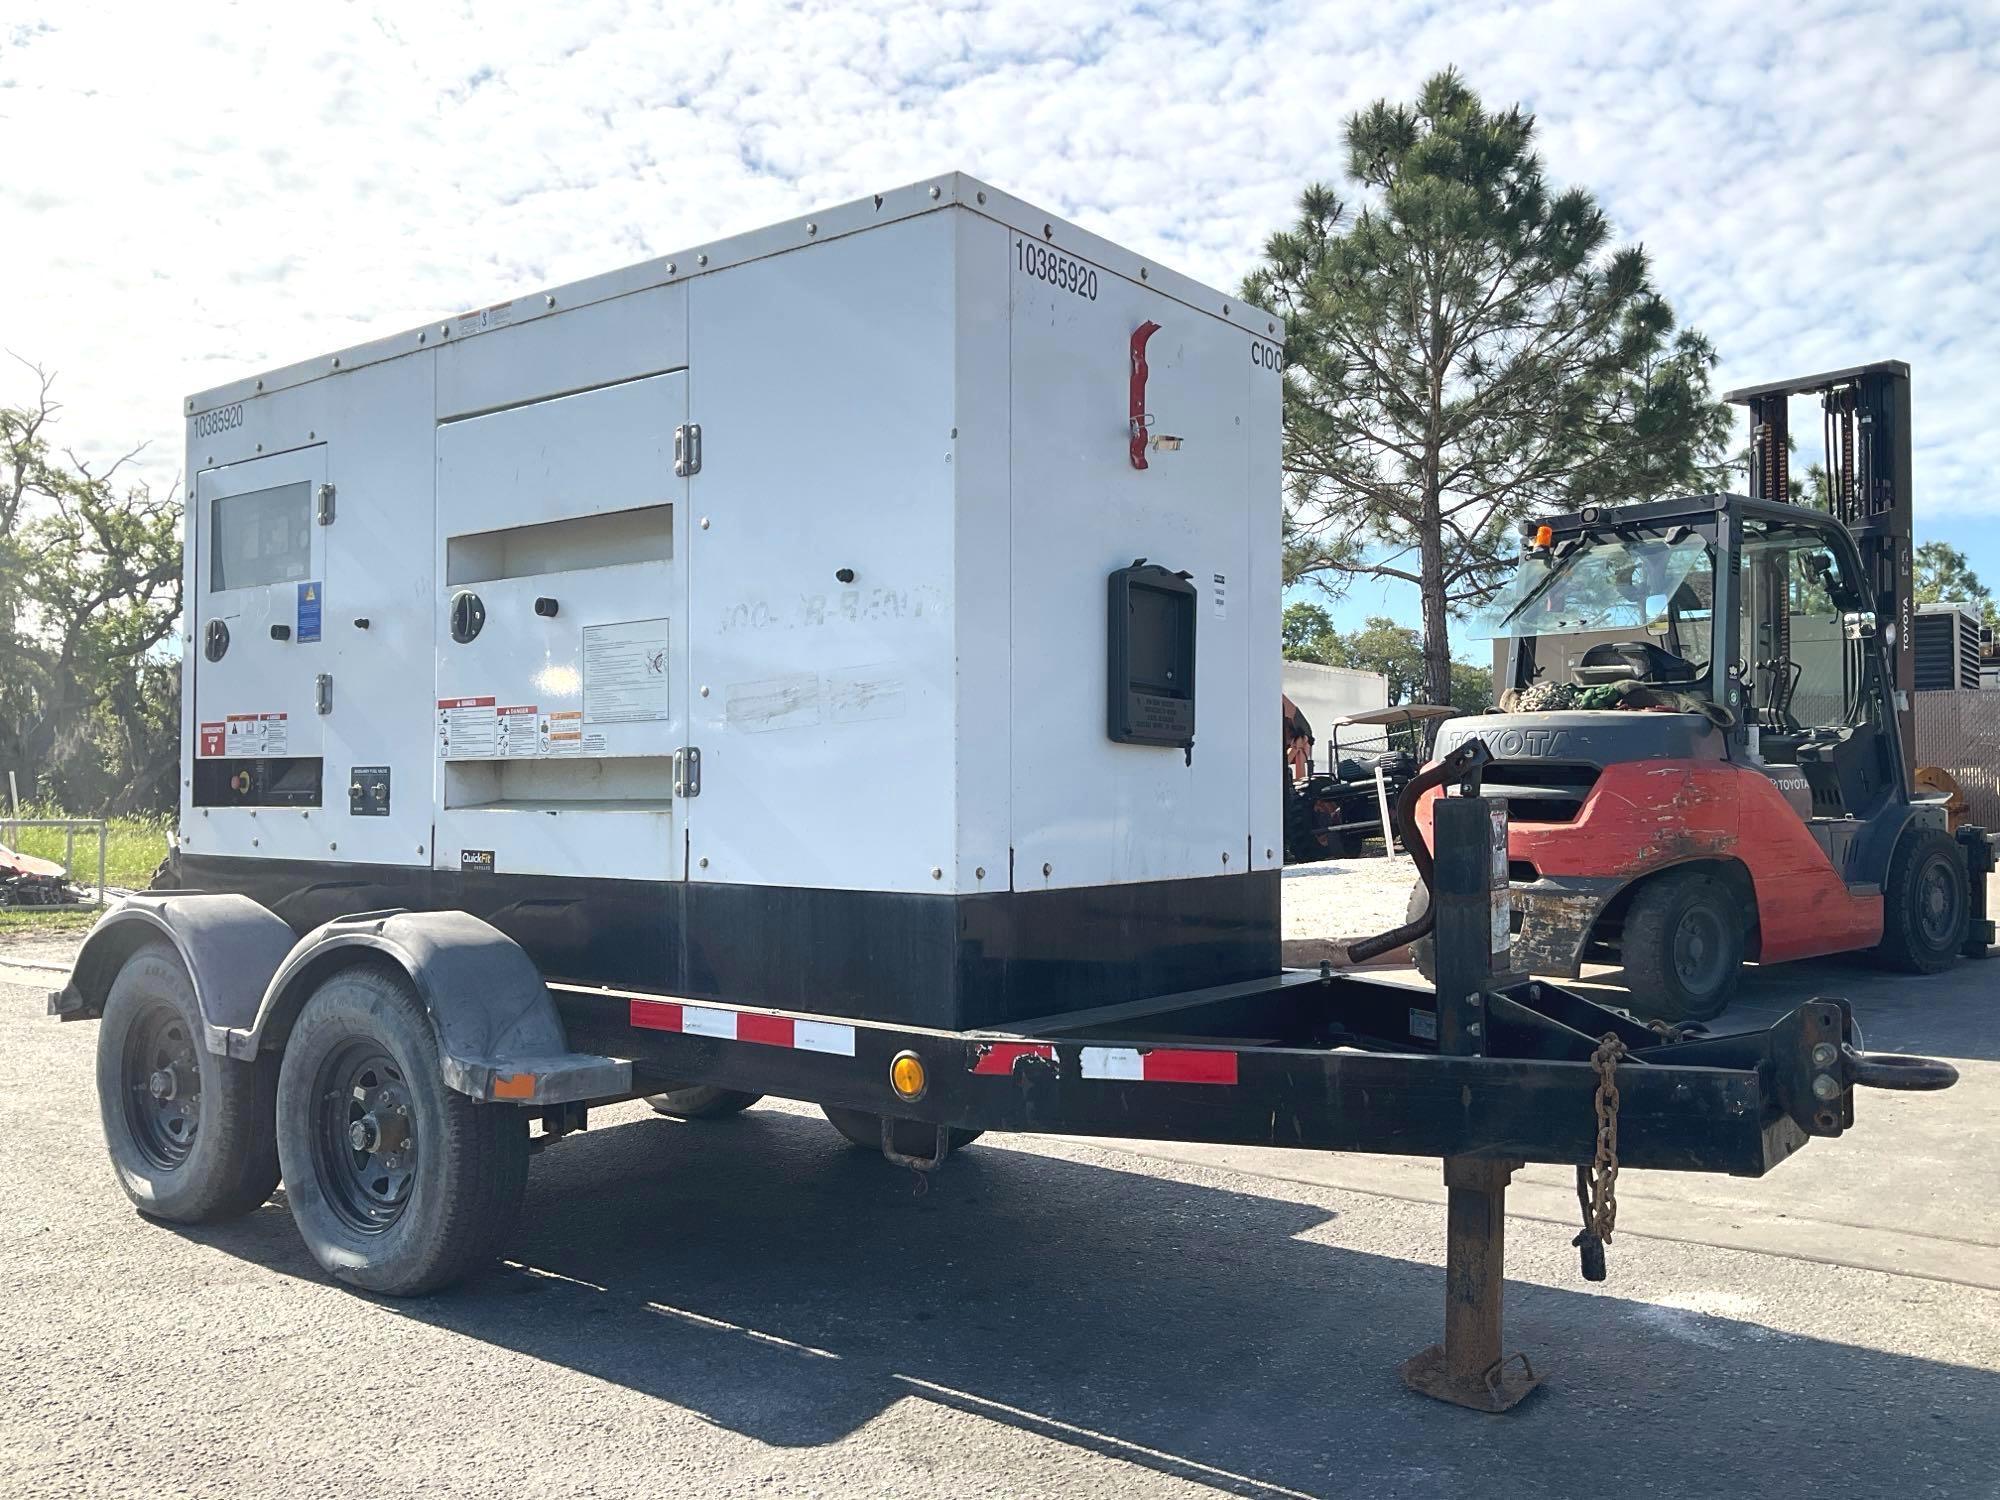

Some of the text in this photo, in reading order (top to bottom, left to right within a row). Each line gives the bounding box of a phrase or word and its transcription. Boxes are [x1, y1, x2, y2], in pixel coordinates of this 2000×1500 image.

[1016, 239, 1097, 301] 10385920
[1251, 341, 1283, 373] C100
[194, 404, 243, 439] 10385920
[1902, 596, 1910, 651] TOYOTA
[1778, 778, 1810, 791] TOYOTA
[462, 852, 491, 863] QuickFit
